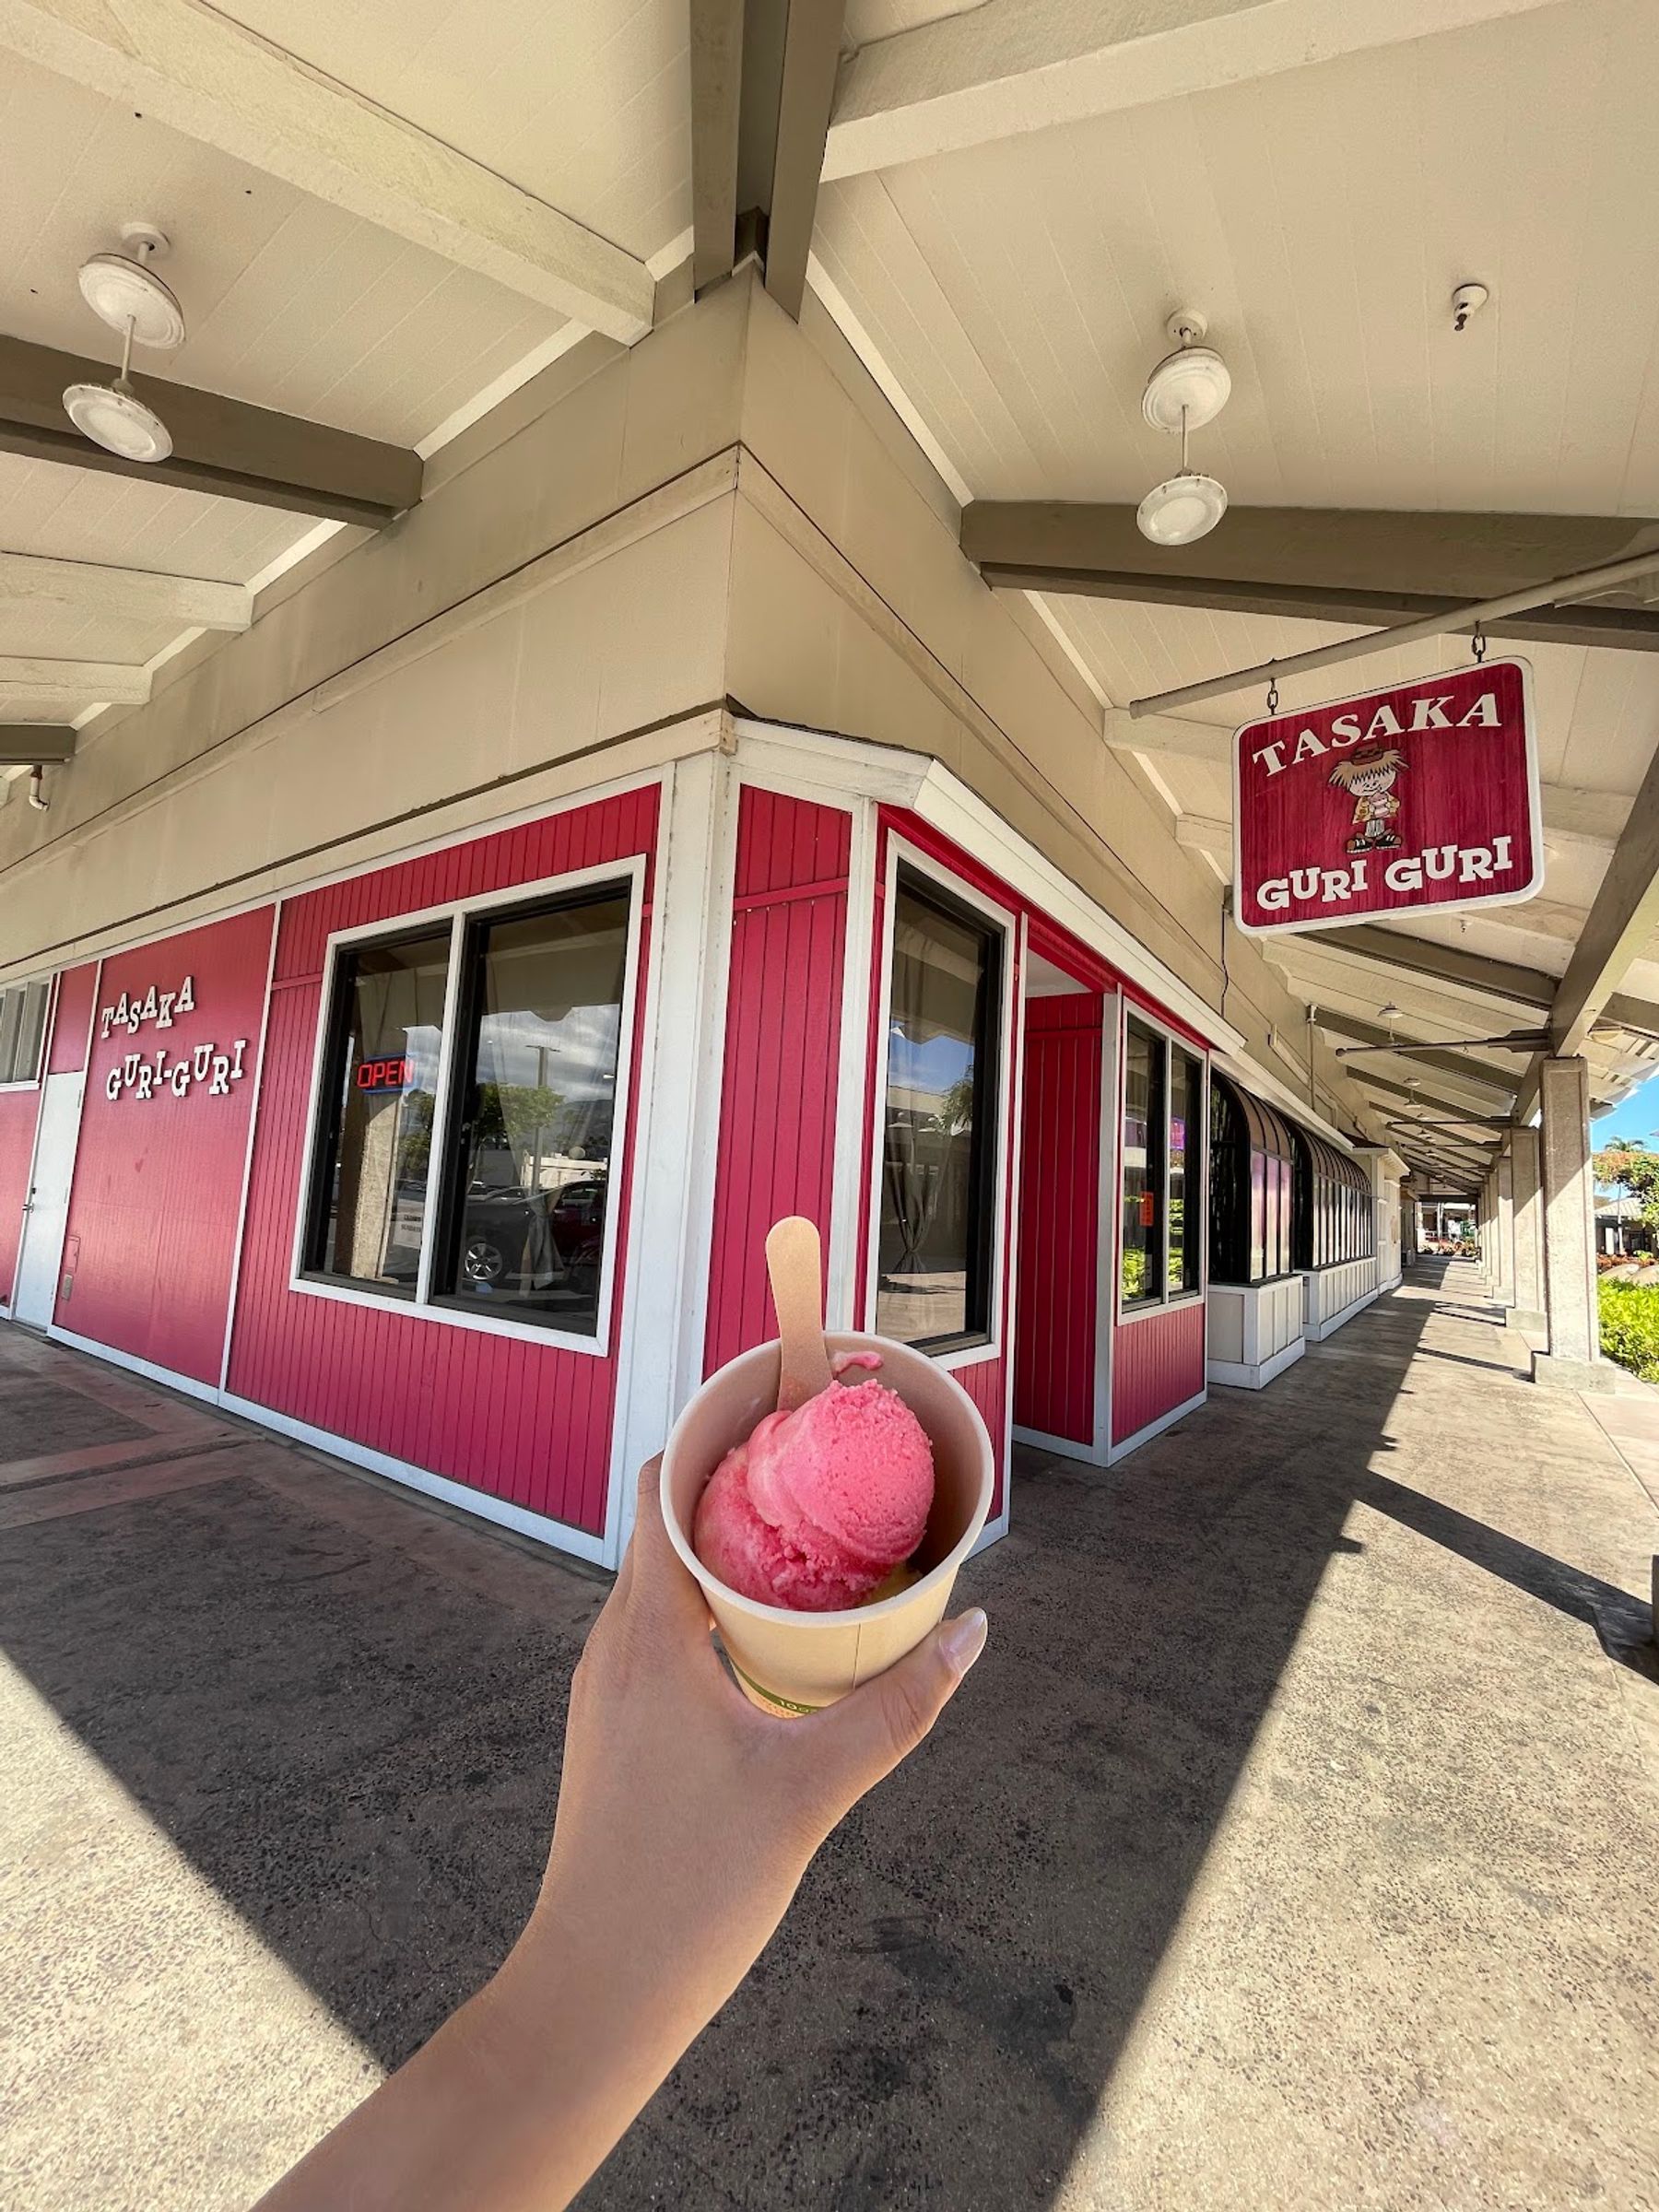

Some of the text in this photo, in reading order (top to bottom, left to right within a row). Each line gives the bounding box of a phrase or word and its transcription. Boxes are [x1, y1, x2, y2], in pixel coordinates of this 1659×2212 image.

[1253, 693, 1502, 777] TASAKA
[1256, 836, 1512, 911] GURI GURI
[100, 975, 194, 1039] TASAKA
[106, 1039, 247, 1100] GURI-GURI
[357, 1059, 415, 1088] OPEN
